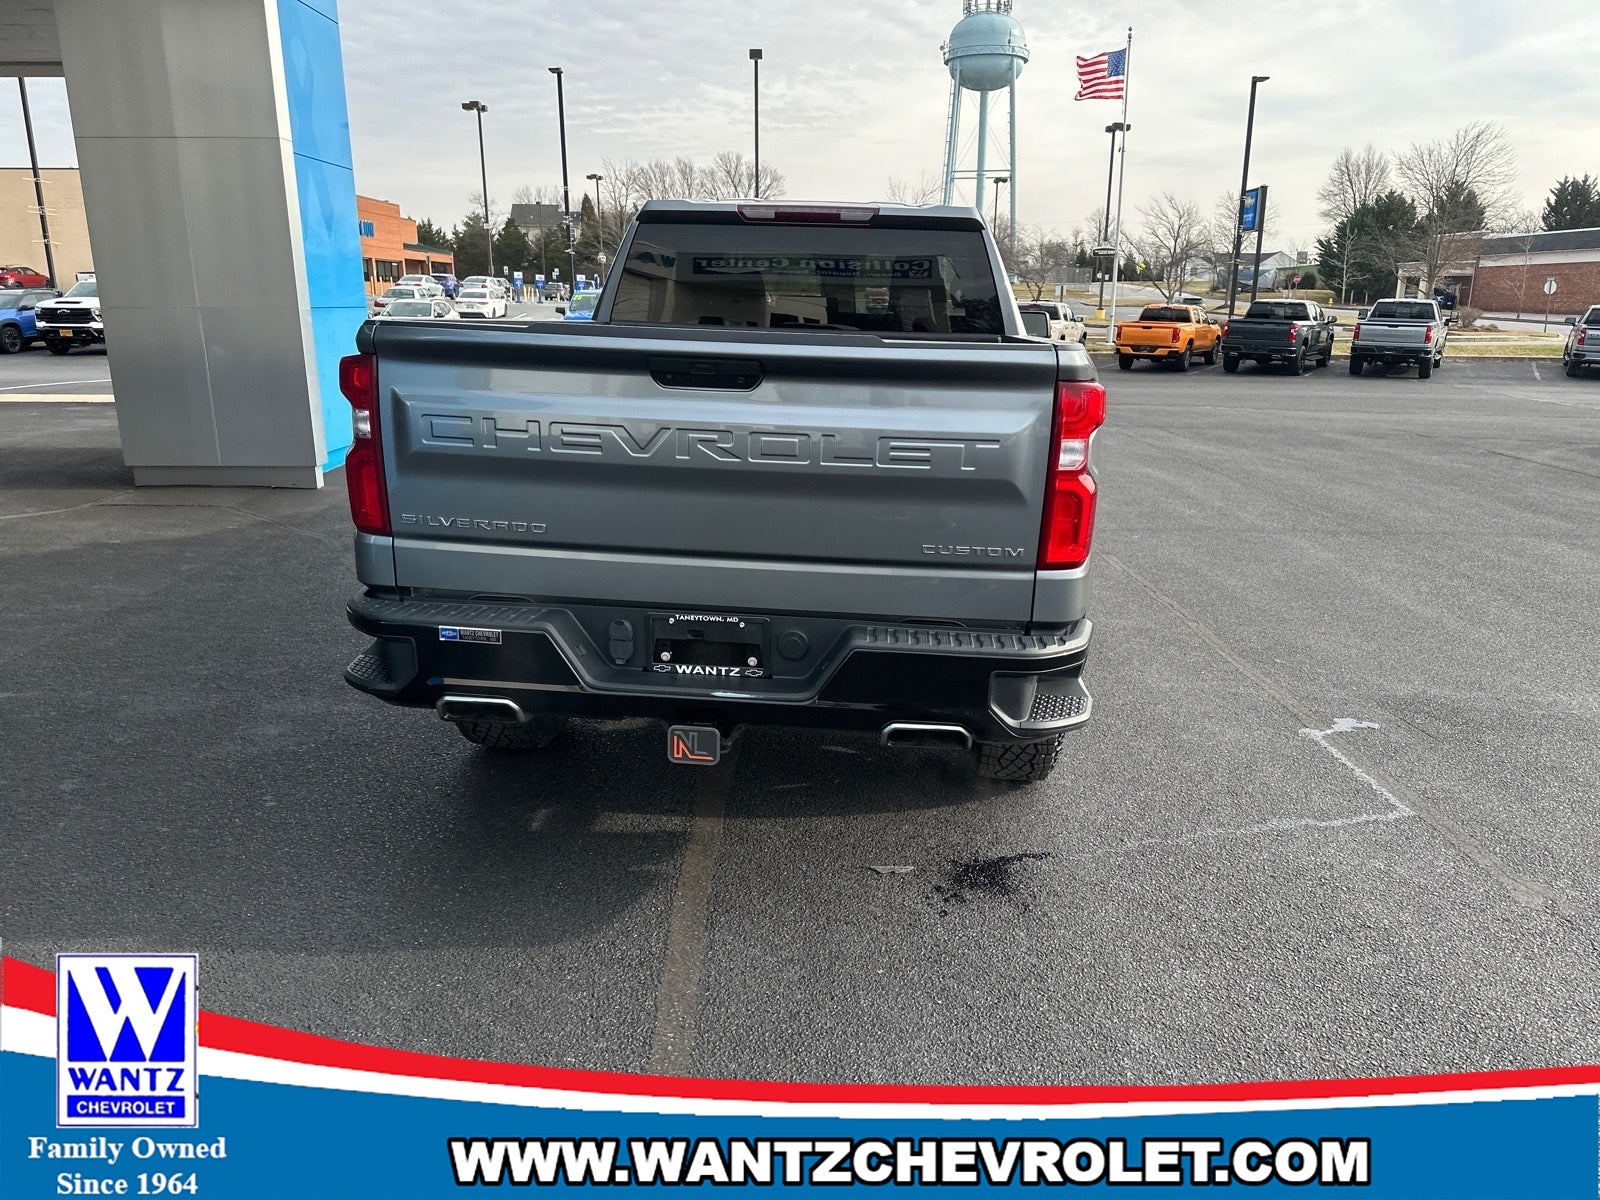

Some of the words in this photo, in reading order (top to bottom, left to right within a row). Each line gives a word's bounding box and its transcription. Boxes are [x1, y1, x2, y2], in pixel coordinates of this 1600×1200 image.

[420, 413, 1001, 471] CHEVROLET
[401, 513, 548, 534] SILVERADO
[921, 544, 1025, 557] CUSTOM
[675, 664, 741, 677] WANTZ
